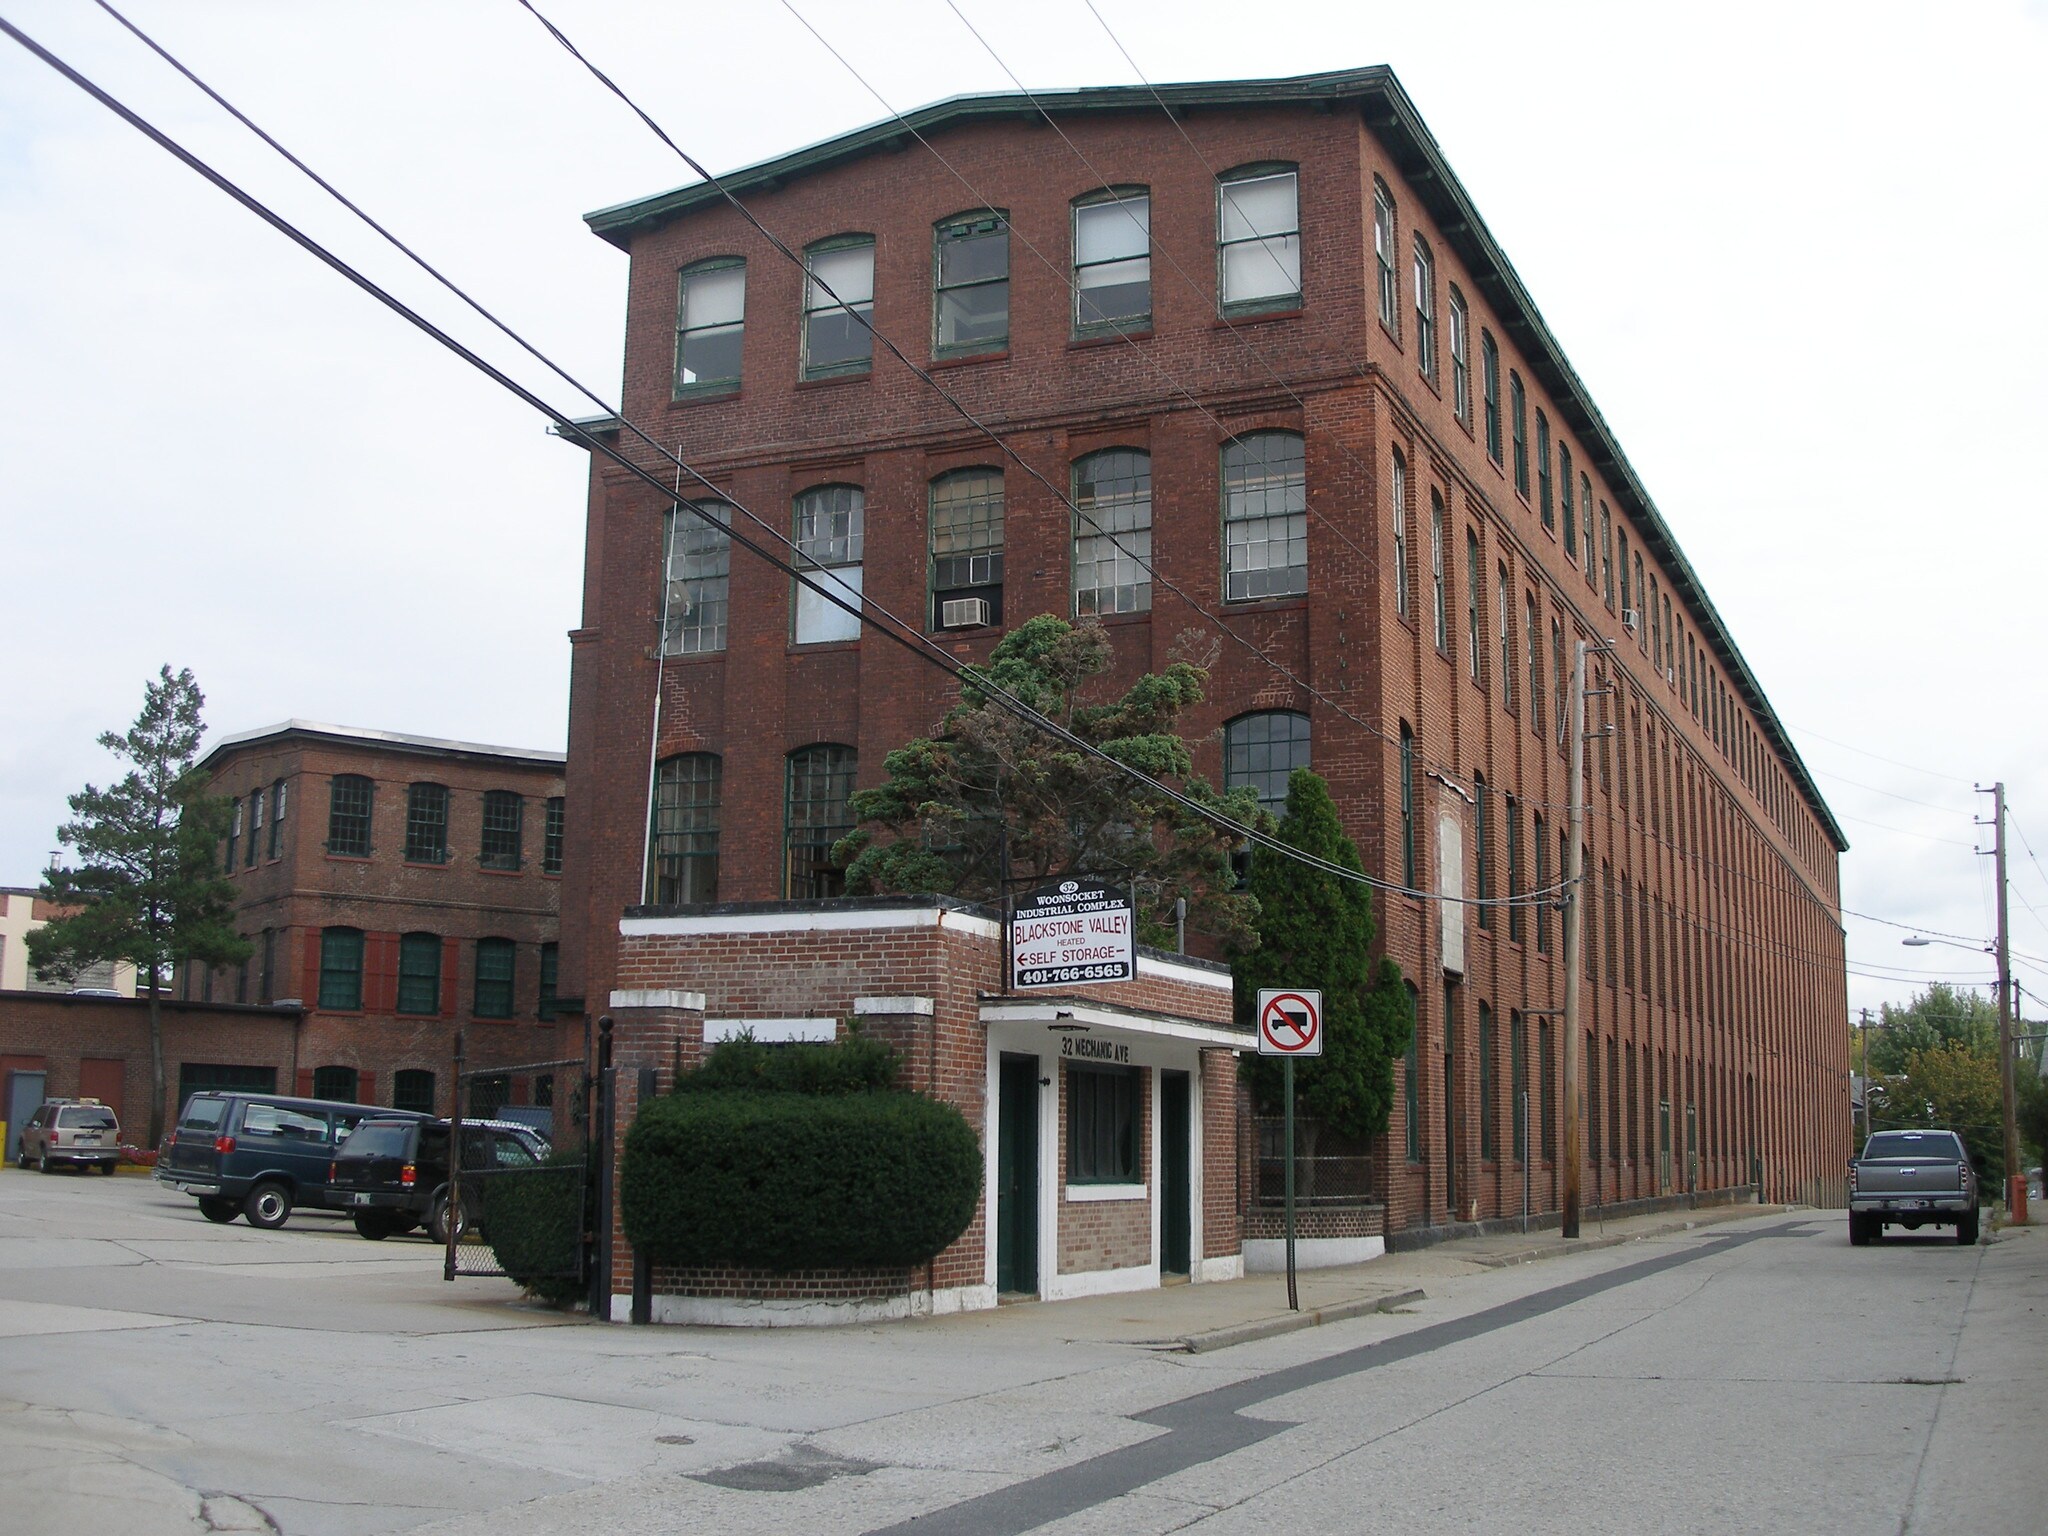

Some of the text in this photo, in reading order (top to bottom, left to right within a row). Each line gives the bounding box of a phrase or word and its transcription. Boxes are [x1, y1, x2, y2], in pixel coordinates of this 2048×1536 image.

[1062, 882, 1075, 892] 32
[1036, 890, 1105, 905] WOONSOCKET
[1016, 899, 1125, 919] INDUSTRIAL COMPLEX
[1015, 915, 1128, 945] BLACKSTONE VALLEY
[1056, 937, 1086, 947] HEATED
[1029, 946, 1115, 965] SELF STORAGE
[1023, 964, 1123, 984] 401-766-6565
[1061, 1036, 1129, 1063] 32 MECHANIC AVE
